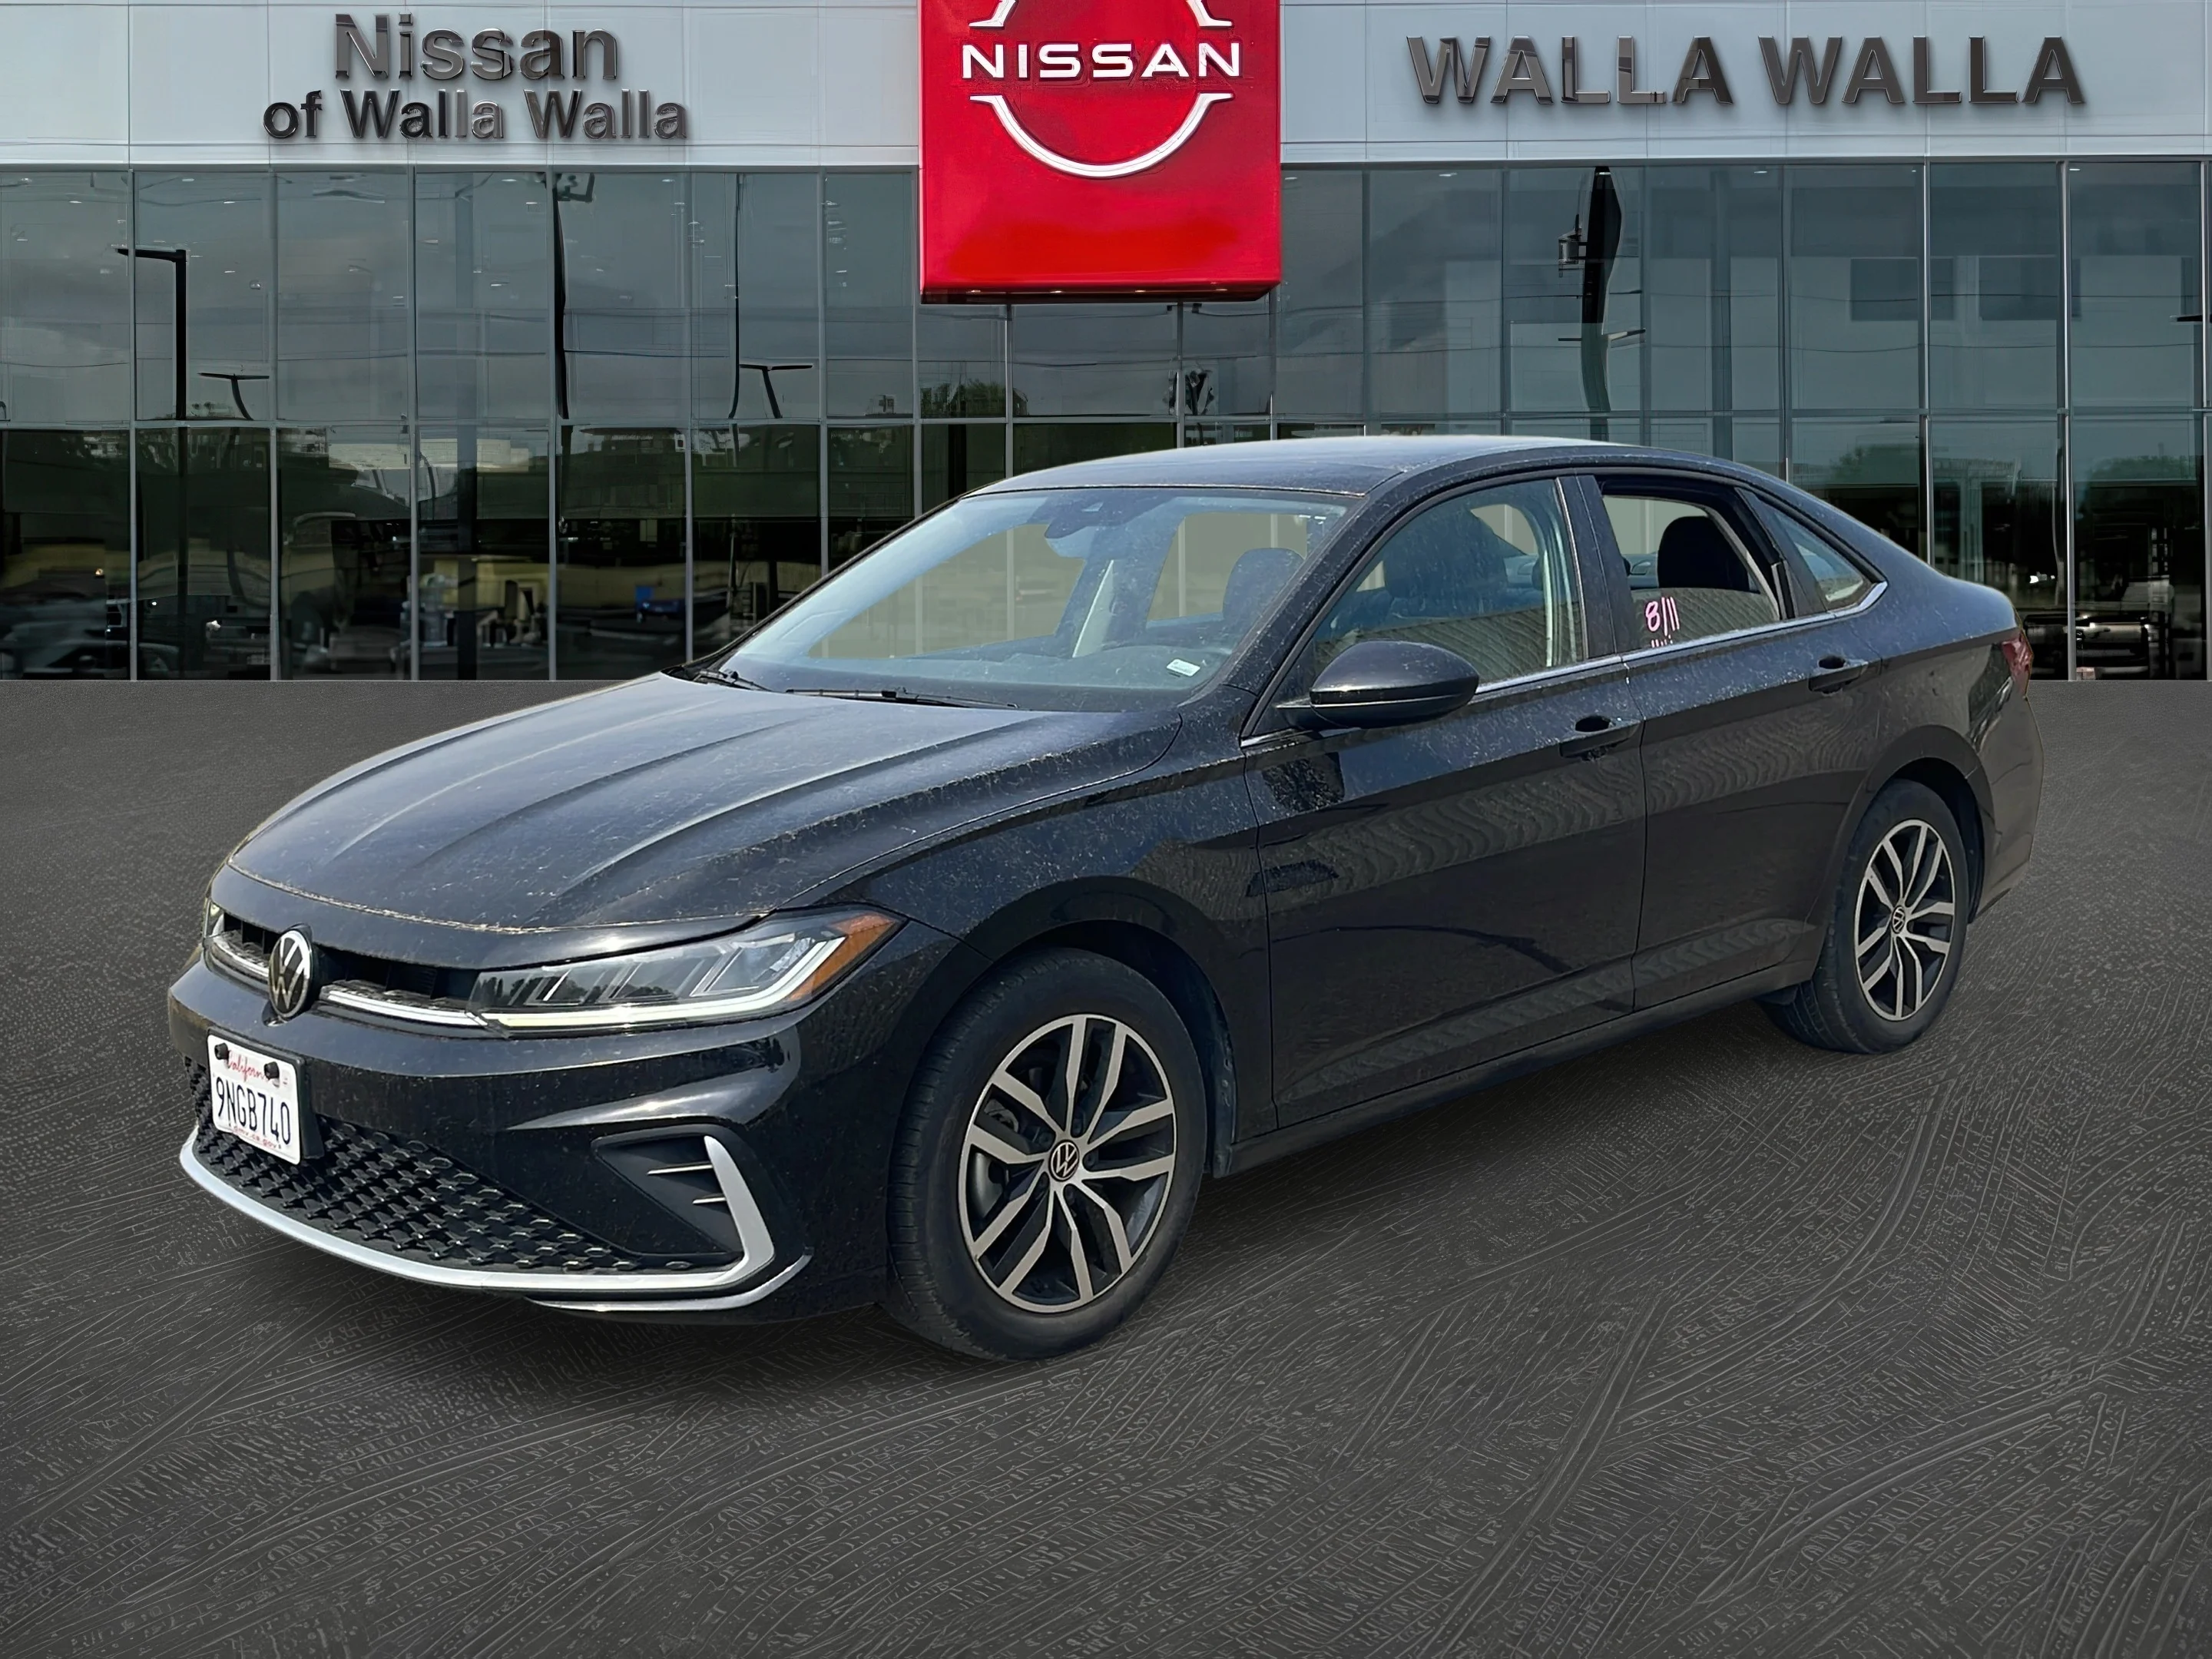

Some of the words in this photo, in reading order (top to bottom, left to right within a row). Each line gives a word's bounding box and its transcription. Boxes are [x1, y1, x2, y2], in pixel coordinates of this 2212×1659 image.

[335, 12, 618, 80] Nissan
[962, 42, 1240, 78] NISSAN
[1406, 35, 1733, 105] WALLA
[1758, 35, 2085, 105] WALLA
[263, 90, 323, 138] of
[340, 88, 504, 139] Walla
[523, 88, 687, 139] Walla
[225, 1049, 270, 1083] Californ
[216, 1076, 291, 1145] 9NGB740
